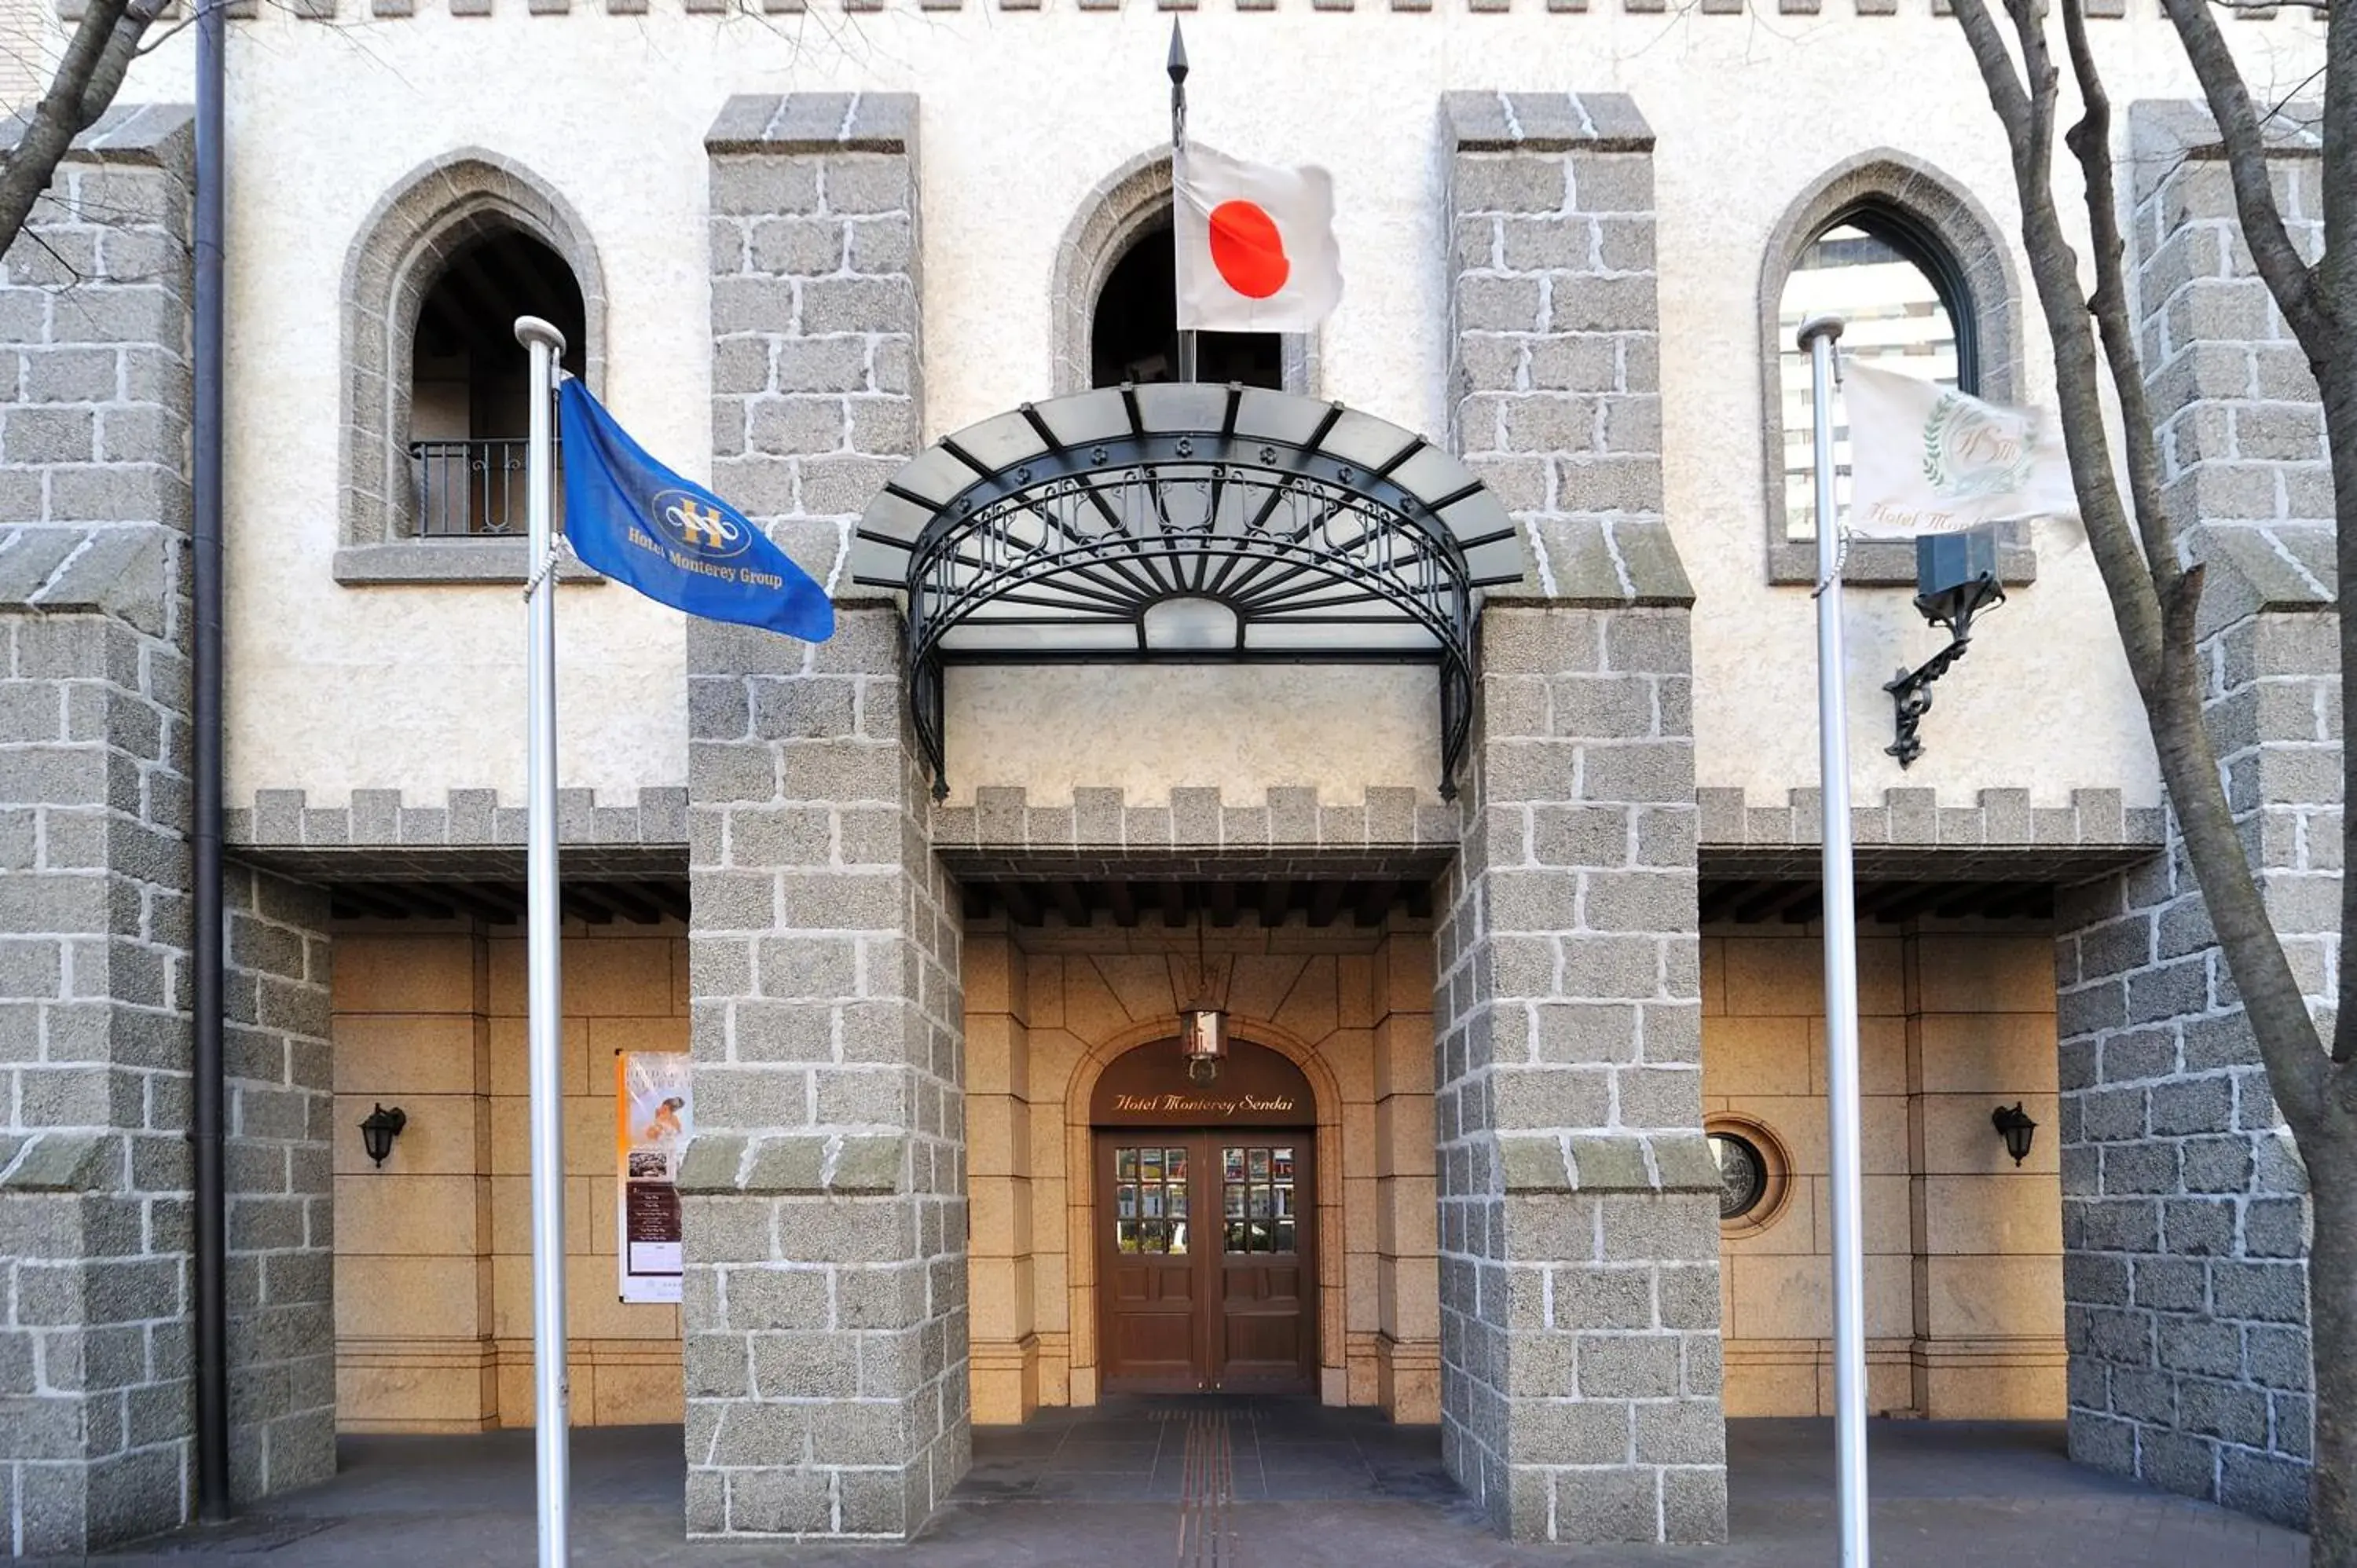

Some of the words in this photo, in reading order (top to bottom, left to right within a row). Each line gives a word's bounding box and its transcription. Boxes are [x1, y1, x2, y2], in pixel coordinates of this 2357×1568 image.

[1862, 502, 1920, 527] Hotel
[629, 526, 665, 559] Hotel
[669, 549, 735, 583] Monterey
[740, 567, 783, 590] Group
[1113, 1094, 1160, 1110] Hotel
[1164, 1094, 1236, 1116] Monterey
[1239, 1094, 1295, 1110] Sendai
